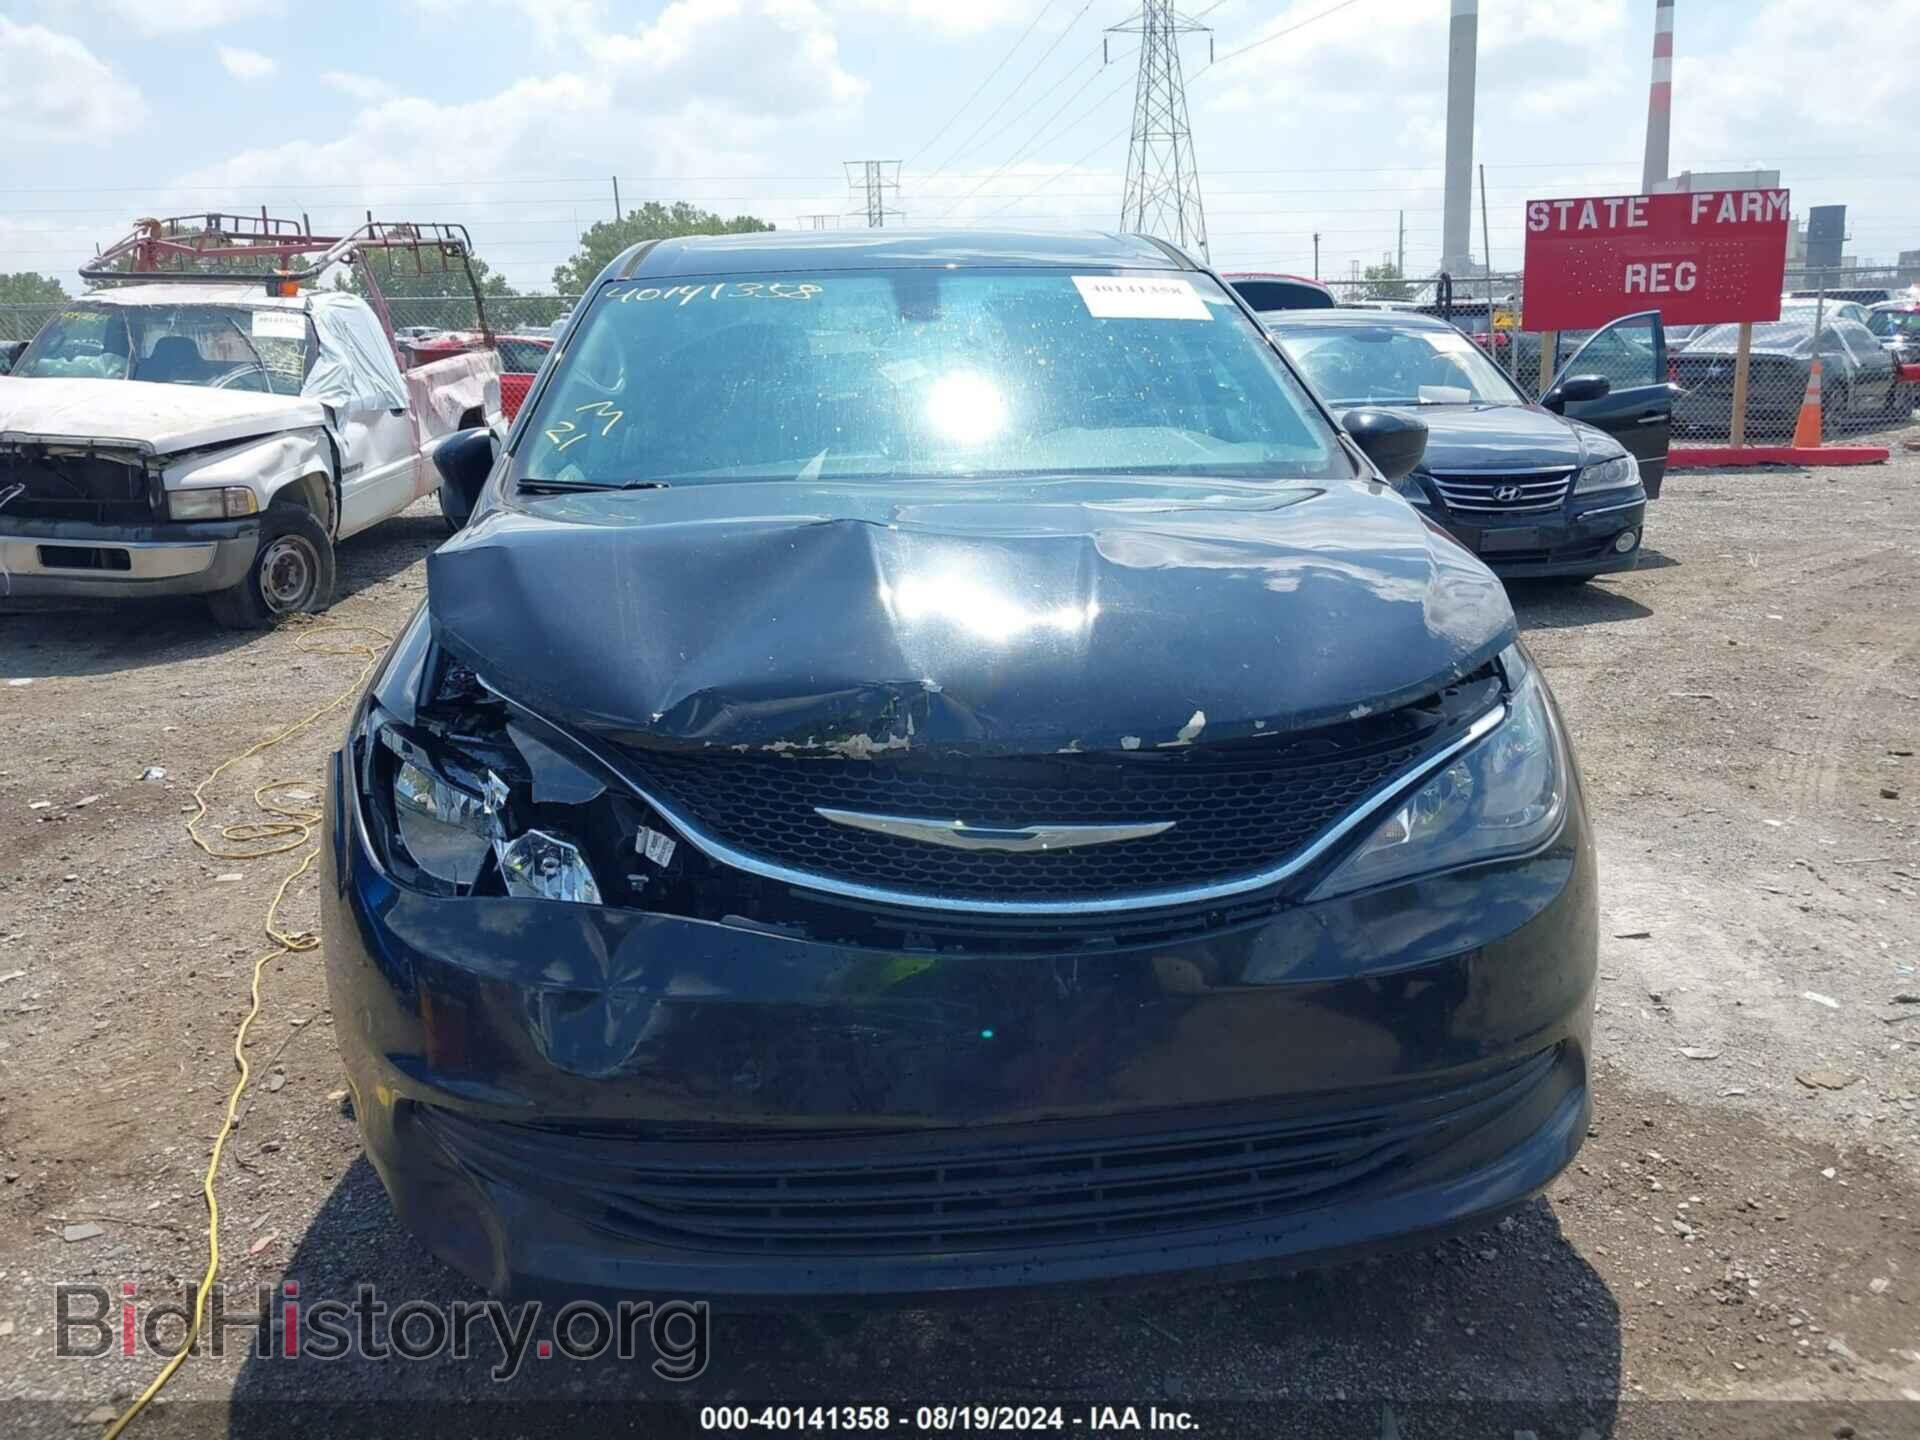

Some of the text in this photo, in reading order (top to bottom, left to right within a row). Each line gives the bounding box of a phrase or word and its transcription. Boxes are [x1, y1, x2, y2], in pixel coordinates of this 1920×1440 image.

[1528, 191, 1788, 231] STATE FARM
[606, 283, 823, 305] 40141358
[1625, 262, 1697, 294] REG
